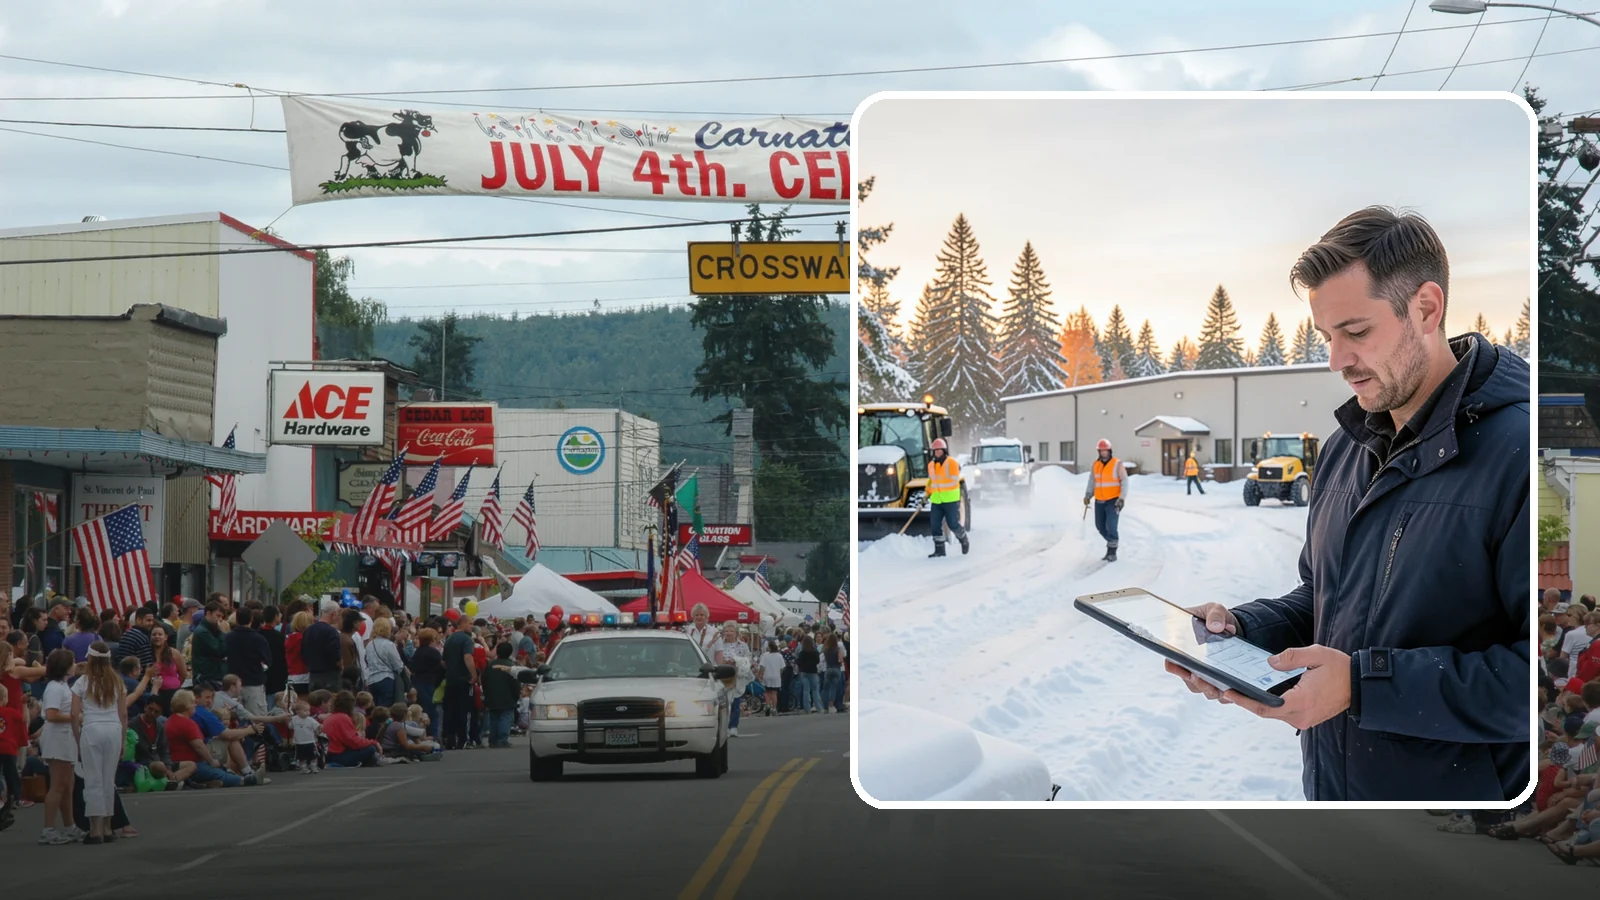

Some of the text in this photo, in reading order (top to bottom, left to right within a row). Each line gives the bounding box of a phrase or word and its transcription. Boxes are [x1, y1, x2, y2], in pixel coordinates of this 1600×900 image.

[481, 141, 604, 192] JULY
[633, 150, 746, 198] 4th.
[697, 254, 850, 280] CROSSWA
[283, 380, 373, 420] ACE
[406, 410, 485, 422] CEDAR LOG
[283, 421, 371, 436] Hardware
[96, 485, 124, 494] Vincent
[126, 485, 135, 494] de
[138, 486, 155, 495] Paul
[212, 516, 330, 536] HARDARE
[688, 526, 741, 535] CRNATION
[699, 535, 730, 543] GLASS
